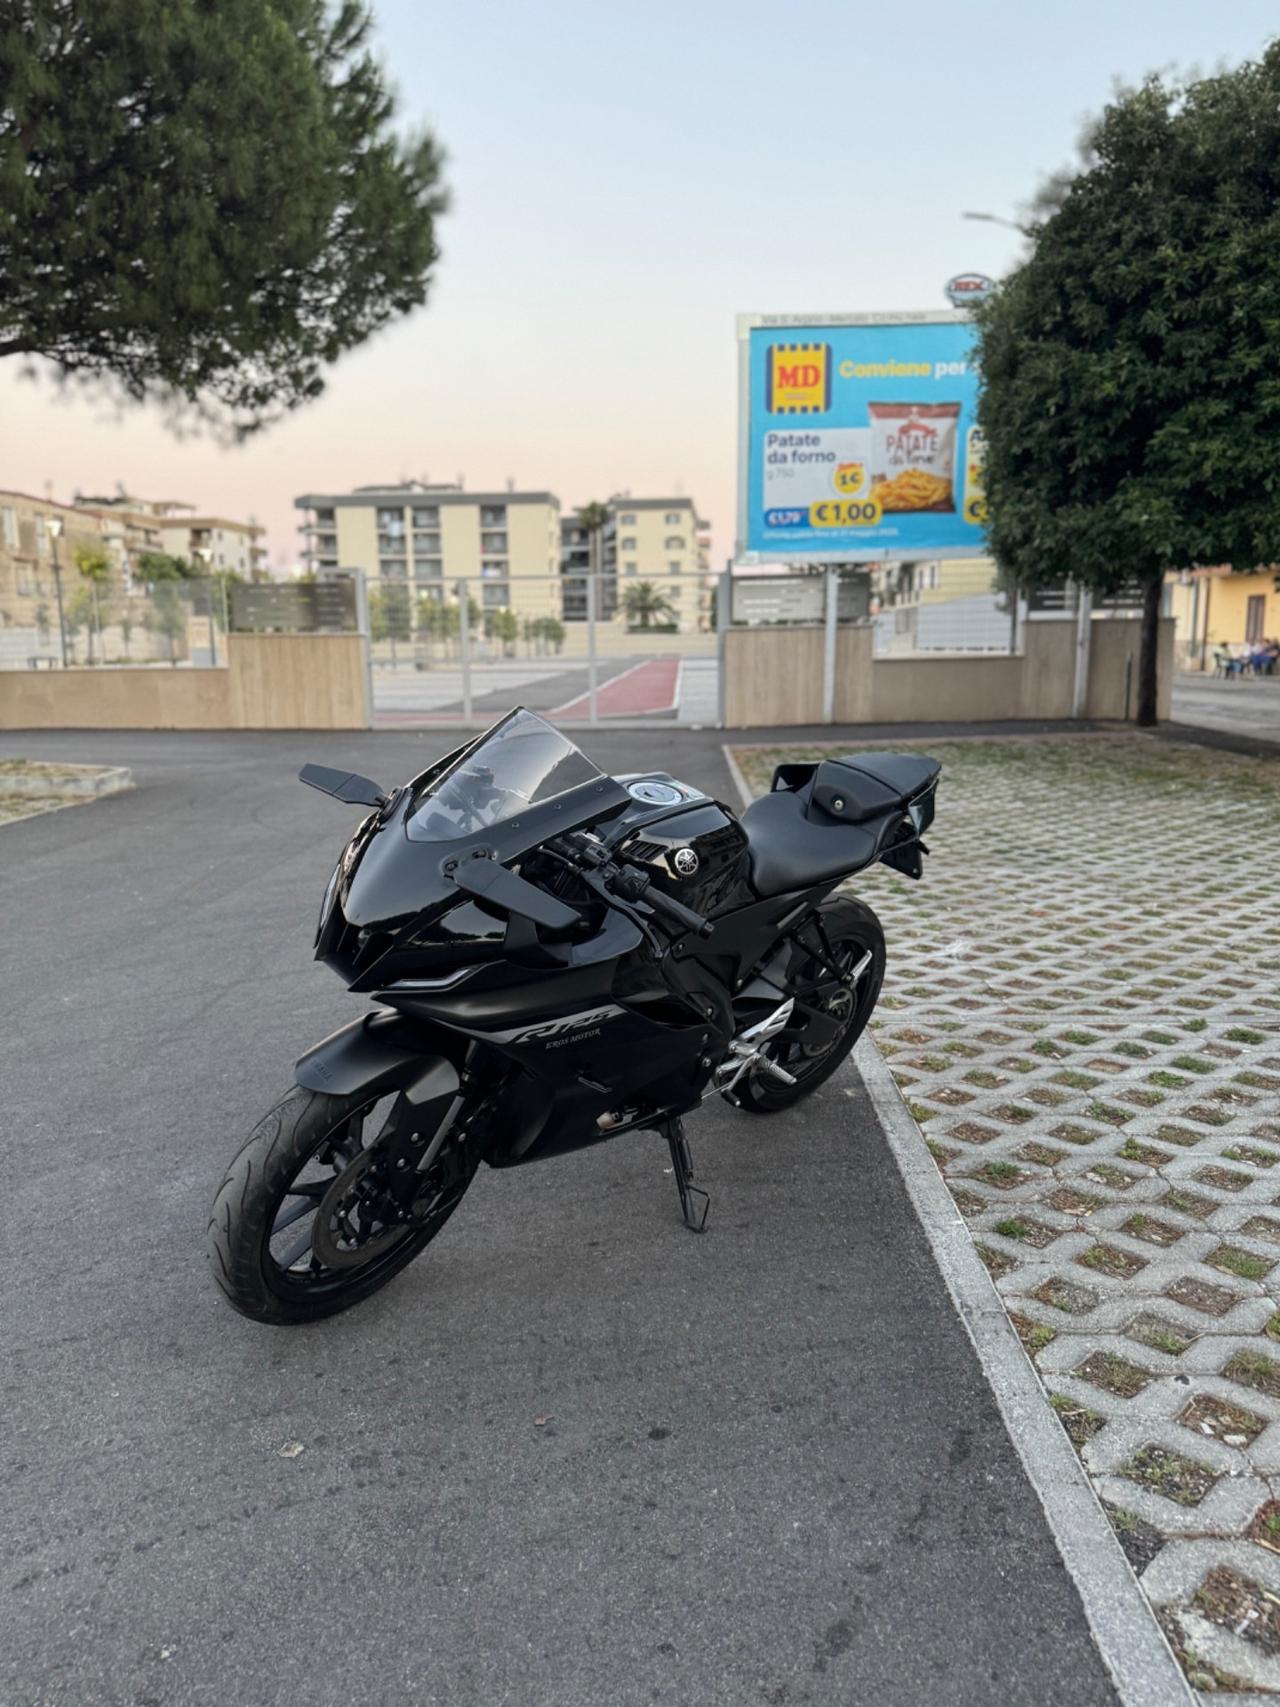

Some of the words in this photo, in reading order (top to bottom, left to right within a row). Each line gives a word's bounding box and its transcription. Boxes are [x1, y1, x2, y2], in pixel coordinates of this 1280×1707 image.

[777, 365, 820, 388] MD
[840, 361, 931, 377] Conviene
[936, 362, 966, 379] per
[768, 434, 821, 448] Patate
[886, 431, 938, 452] PATATE
[767, 450, 787, 464] da
[792, 450, 836, 464] forno
[570, 1028, 601, 1044] MOTOR
